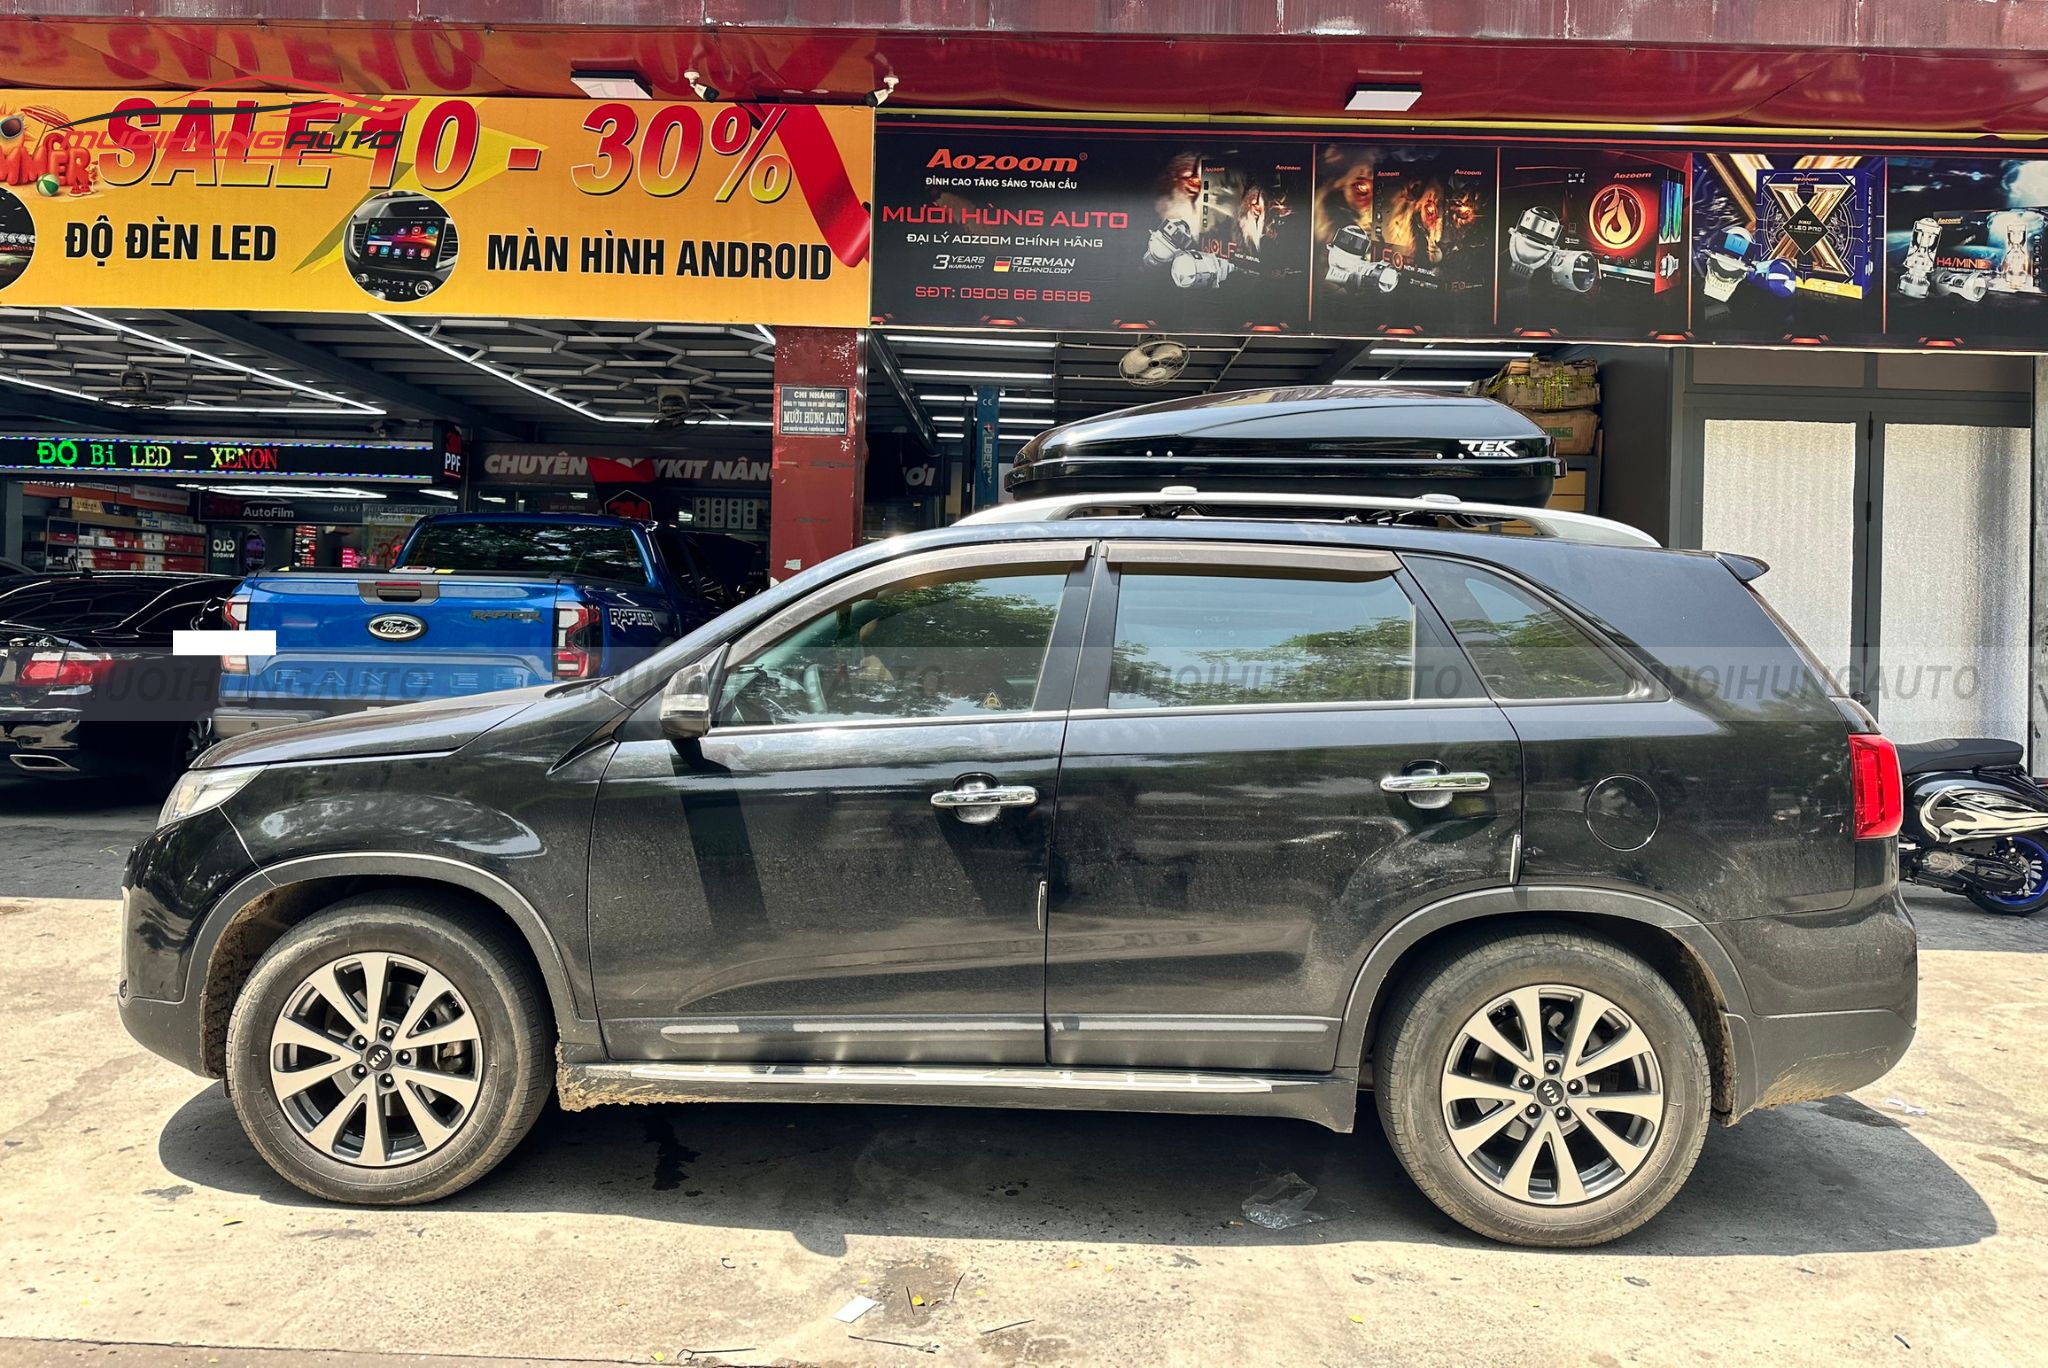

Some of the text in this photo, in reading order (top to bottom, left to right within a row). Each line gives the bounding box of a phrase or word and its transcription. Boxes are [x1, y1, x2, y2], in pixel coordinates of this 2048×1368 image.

[100, 97, 343, 189] SALE
[360, 98, 479, 191] 10
[571, 102, 792, 203] 30%
[951, 178, 972, 187] CAO
[974, 176, 999, 188] TĂNG
[1001, 177, 1028, 189] SÁNG
[1029, 178, 1056, 189] TOÀN
[1058, 176, 1077, 190] CẦU
[882, 201, 1129, 229] MƯỜI HÙNG AUTO
[65, 215, 276, 267] ĐỘ ĐÈN LED
[906, 231, 1103, 248] ĐẠI LÝ AOZOOM CHÍNH HÃNG
[487, 227, 832, 281] MÀN HÌNH ANDROID
[933, 254, 986, 270] 3 YEARS
[1012, 256, 1076, 268] GERMAN
[1012, 266, 1073, 274] TECHNOLOGY
[915, 286, 1091, 303] SĐT: 0909 66 8686
[809, 389, 836, 399] NHÁNH
[825, 412, 845, 425] AUTO
[1459, 440, 1519, 457] TEK
[90, 445, 116, 466] Bi
[130, 445, 172, 467] LED
[210, 447, 279, 470] XENON
[444, 452, 461, 472] PPF
[484, 452, 588, 476] CHUYÊN
[711, 456, 773, 481] NÂN
[242, 507, 294, 518] AutoFilm
[471, 609, 544, 624] RAPTOR
[610, 609, 662, 632] RAPTOR
[379, 619, 408, 634] Ford
[274, 668, 524, 691] RANGER
[368, 1050, 388, 1068] KIA
[1543, 1082, 1560, 1104] KIA
